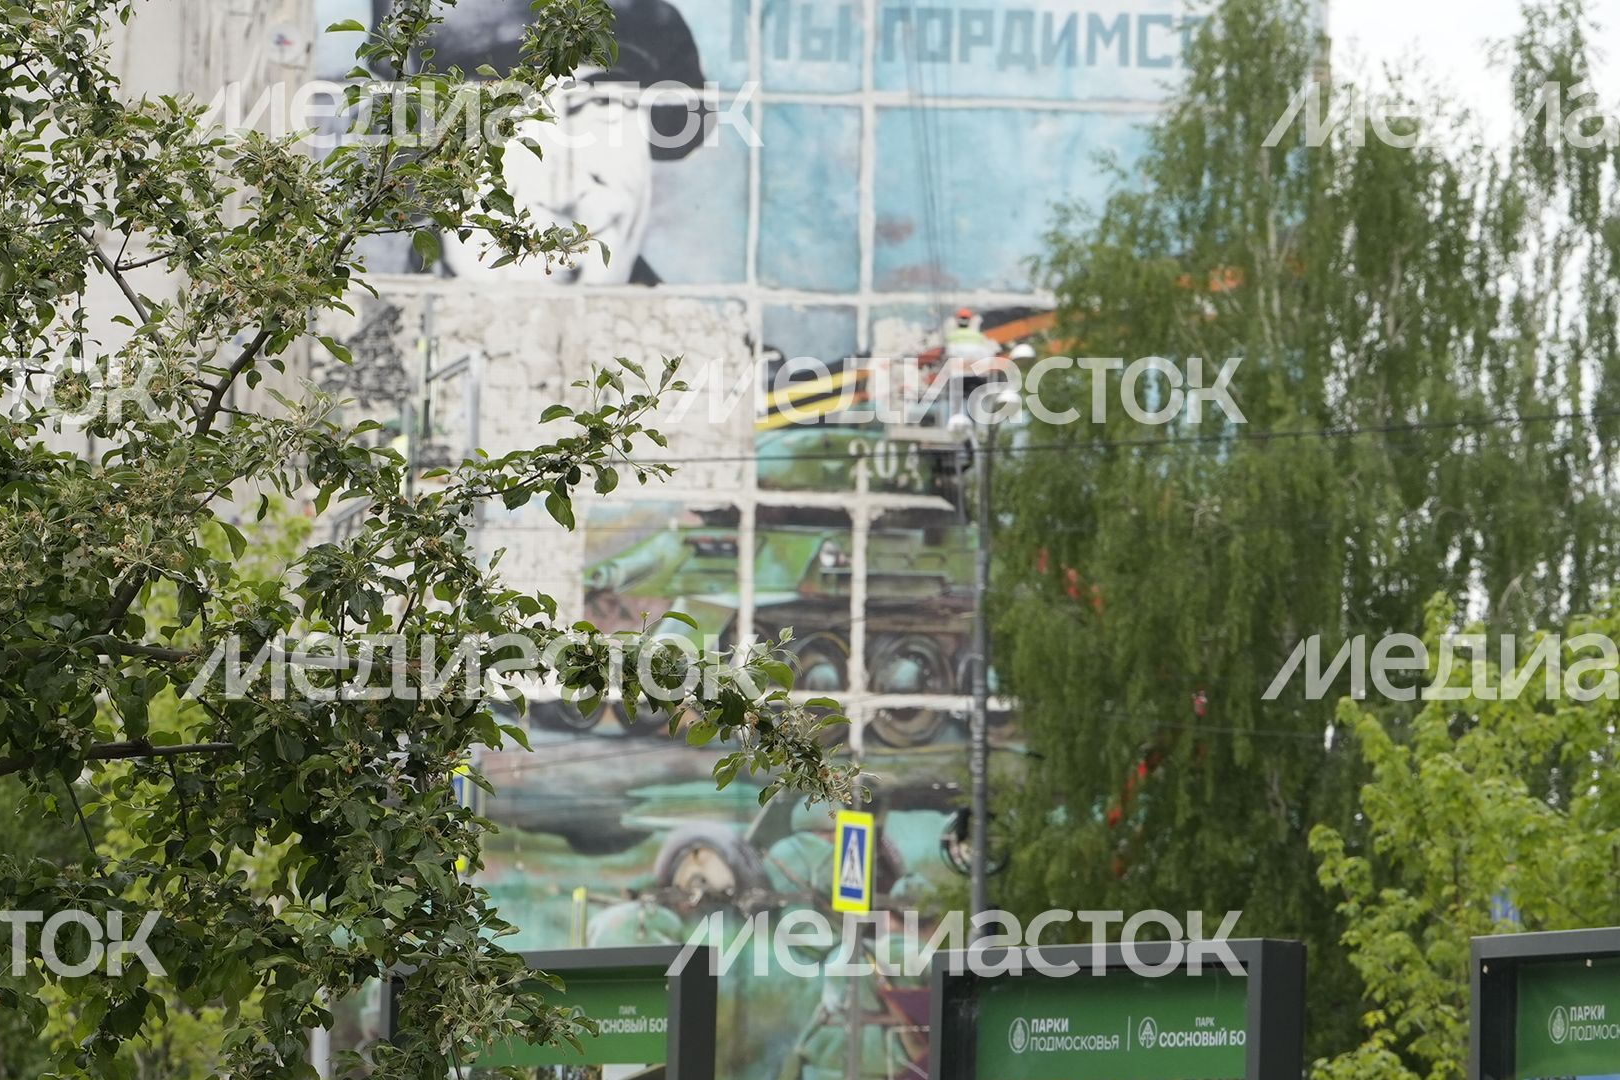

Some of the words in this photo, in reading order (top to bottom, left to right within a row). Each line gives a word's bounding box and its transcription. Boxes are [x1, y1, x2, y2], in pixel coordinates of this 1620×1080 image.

[1570, 1004, 1605, 1021] ПАРКИ
[1031, 1018, 1070, 1033] ПАРКИ
[1195, 1016, 1216, 1027] ПАРК
[1031, 1034, 1120, 1051] ПОДМОСКОВЬЯ
[1159, 1027, 1228, 1048] СОСНОВЫЙ
